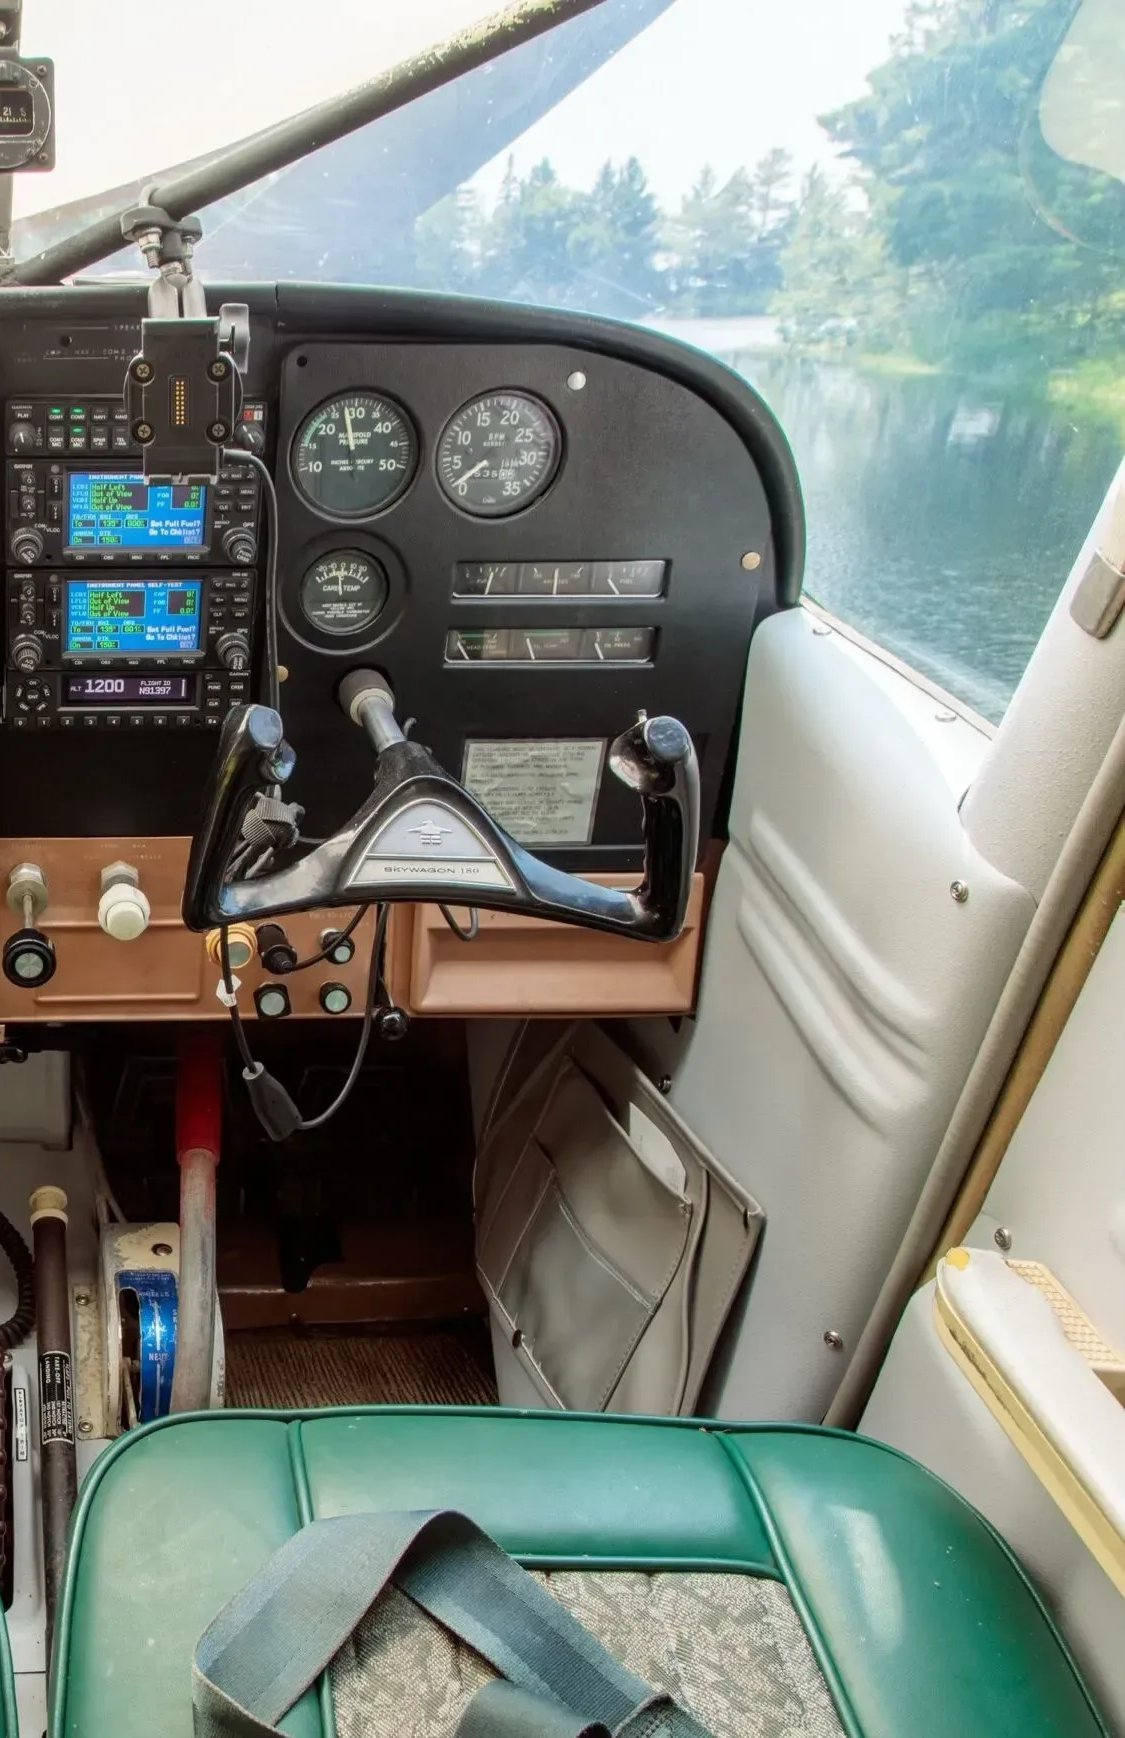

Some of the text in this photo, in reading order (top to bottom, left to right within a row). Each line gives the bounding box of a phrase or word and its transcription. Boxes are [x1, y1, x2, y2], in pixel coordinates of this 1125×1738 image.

[3, 107, 11, 116] 21
[349, 407, 365, 419] 30
[500, 411, 519, 425] 20
[477, 412, 491, 427] 15
[319, 424, 335, 435] 20
[374, 422, 391, 433] 40
[338, 431, 371, 439] MAFOLD
[457, 431, 471, 445] 10
[515, 428, 533, 442] 25
[452, 456, 461, 469] 5
[519, 452, 536, 465] 30
[308, 461, 323, 473] 10
[379, 459, 395, 471] 50
[458, 482, 467, 495] 0
[502, 482, 521, 495] 35
[85, 679, 124, 693] 1200
[139, 686, 171, 695] N91397
[384, 866, 455, 874] SKYWAGON
